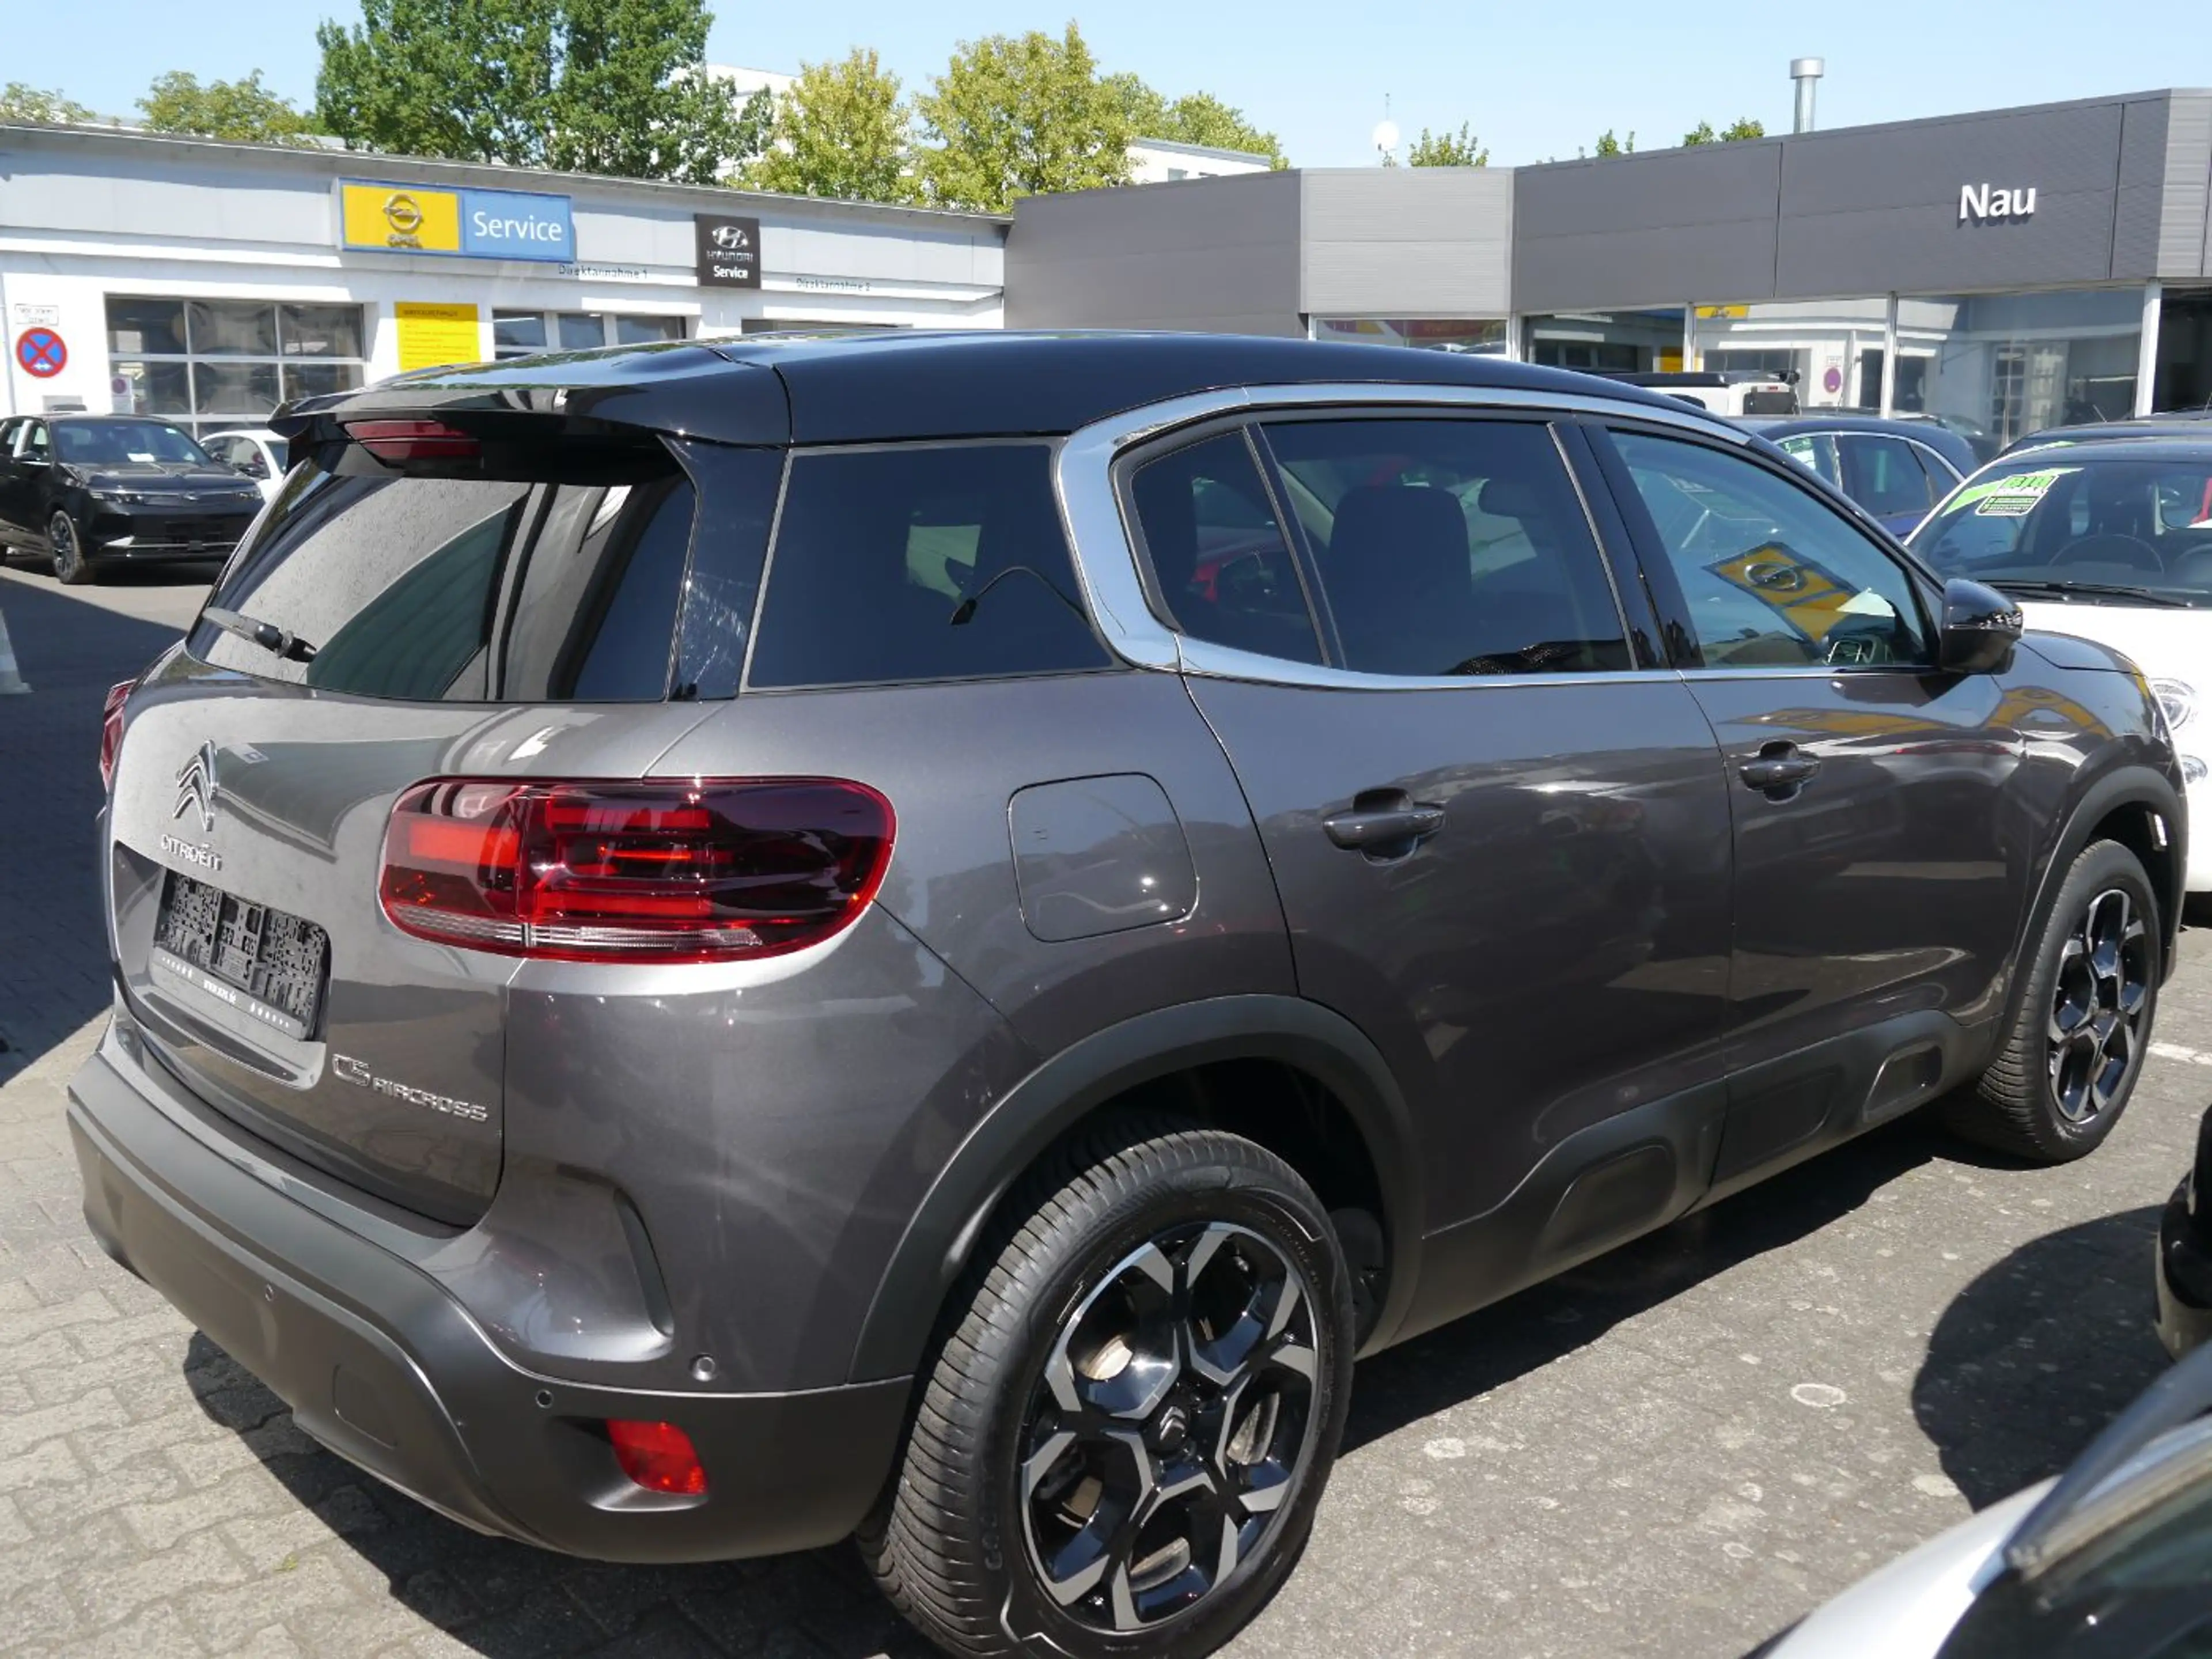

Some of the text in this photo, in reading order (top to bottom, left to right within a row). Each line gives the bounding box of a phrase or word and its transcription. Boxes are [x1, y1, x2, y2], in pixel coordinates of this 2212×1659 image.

[1959, 183, 2036, 218] Nau
[473, 211, 562, 241] Service
[706, 250, 753, 263] HYUNDAI
[713, 265, 748, 279] Service
[161, 834, 222, 871] CITROËN
[332, 1053, 488, 1122] C5 AIRCROSS
